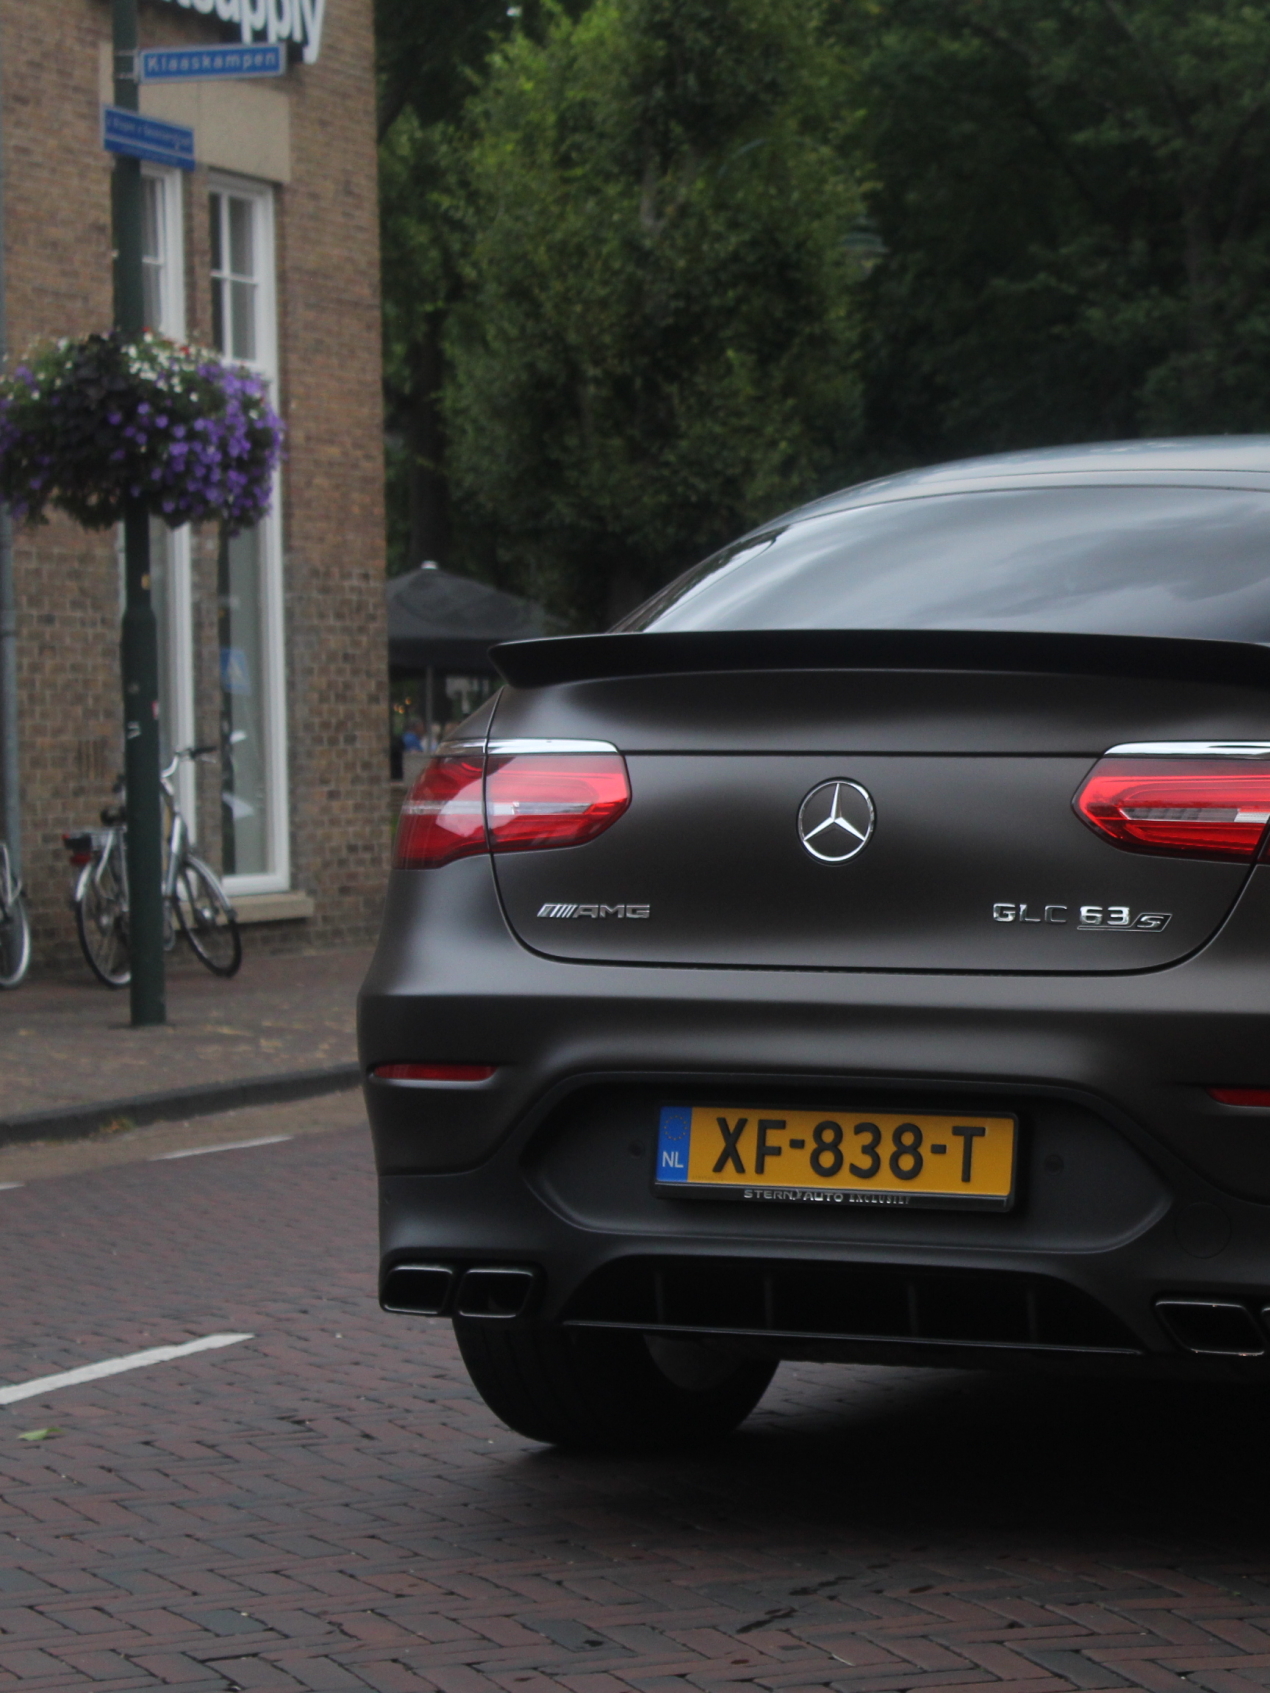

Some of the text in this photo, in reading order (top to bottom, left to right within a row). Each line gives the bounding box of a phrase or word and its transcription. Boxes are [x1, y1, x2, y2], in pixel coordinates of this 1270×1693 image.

[147, 52, 276, 72] Klaaskampen
[572, 904, 650, 918] AMG
[992, 902, 1068, 923] GLC
[1079, 905, 1130, 926] 63
[662, 1150, 684, 1168] NL
[712, 1116, 986, 1183] XF-838-T
[803, 1192, 844, 1202] AUTO
